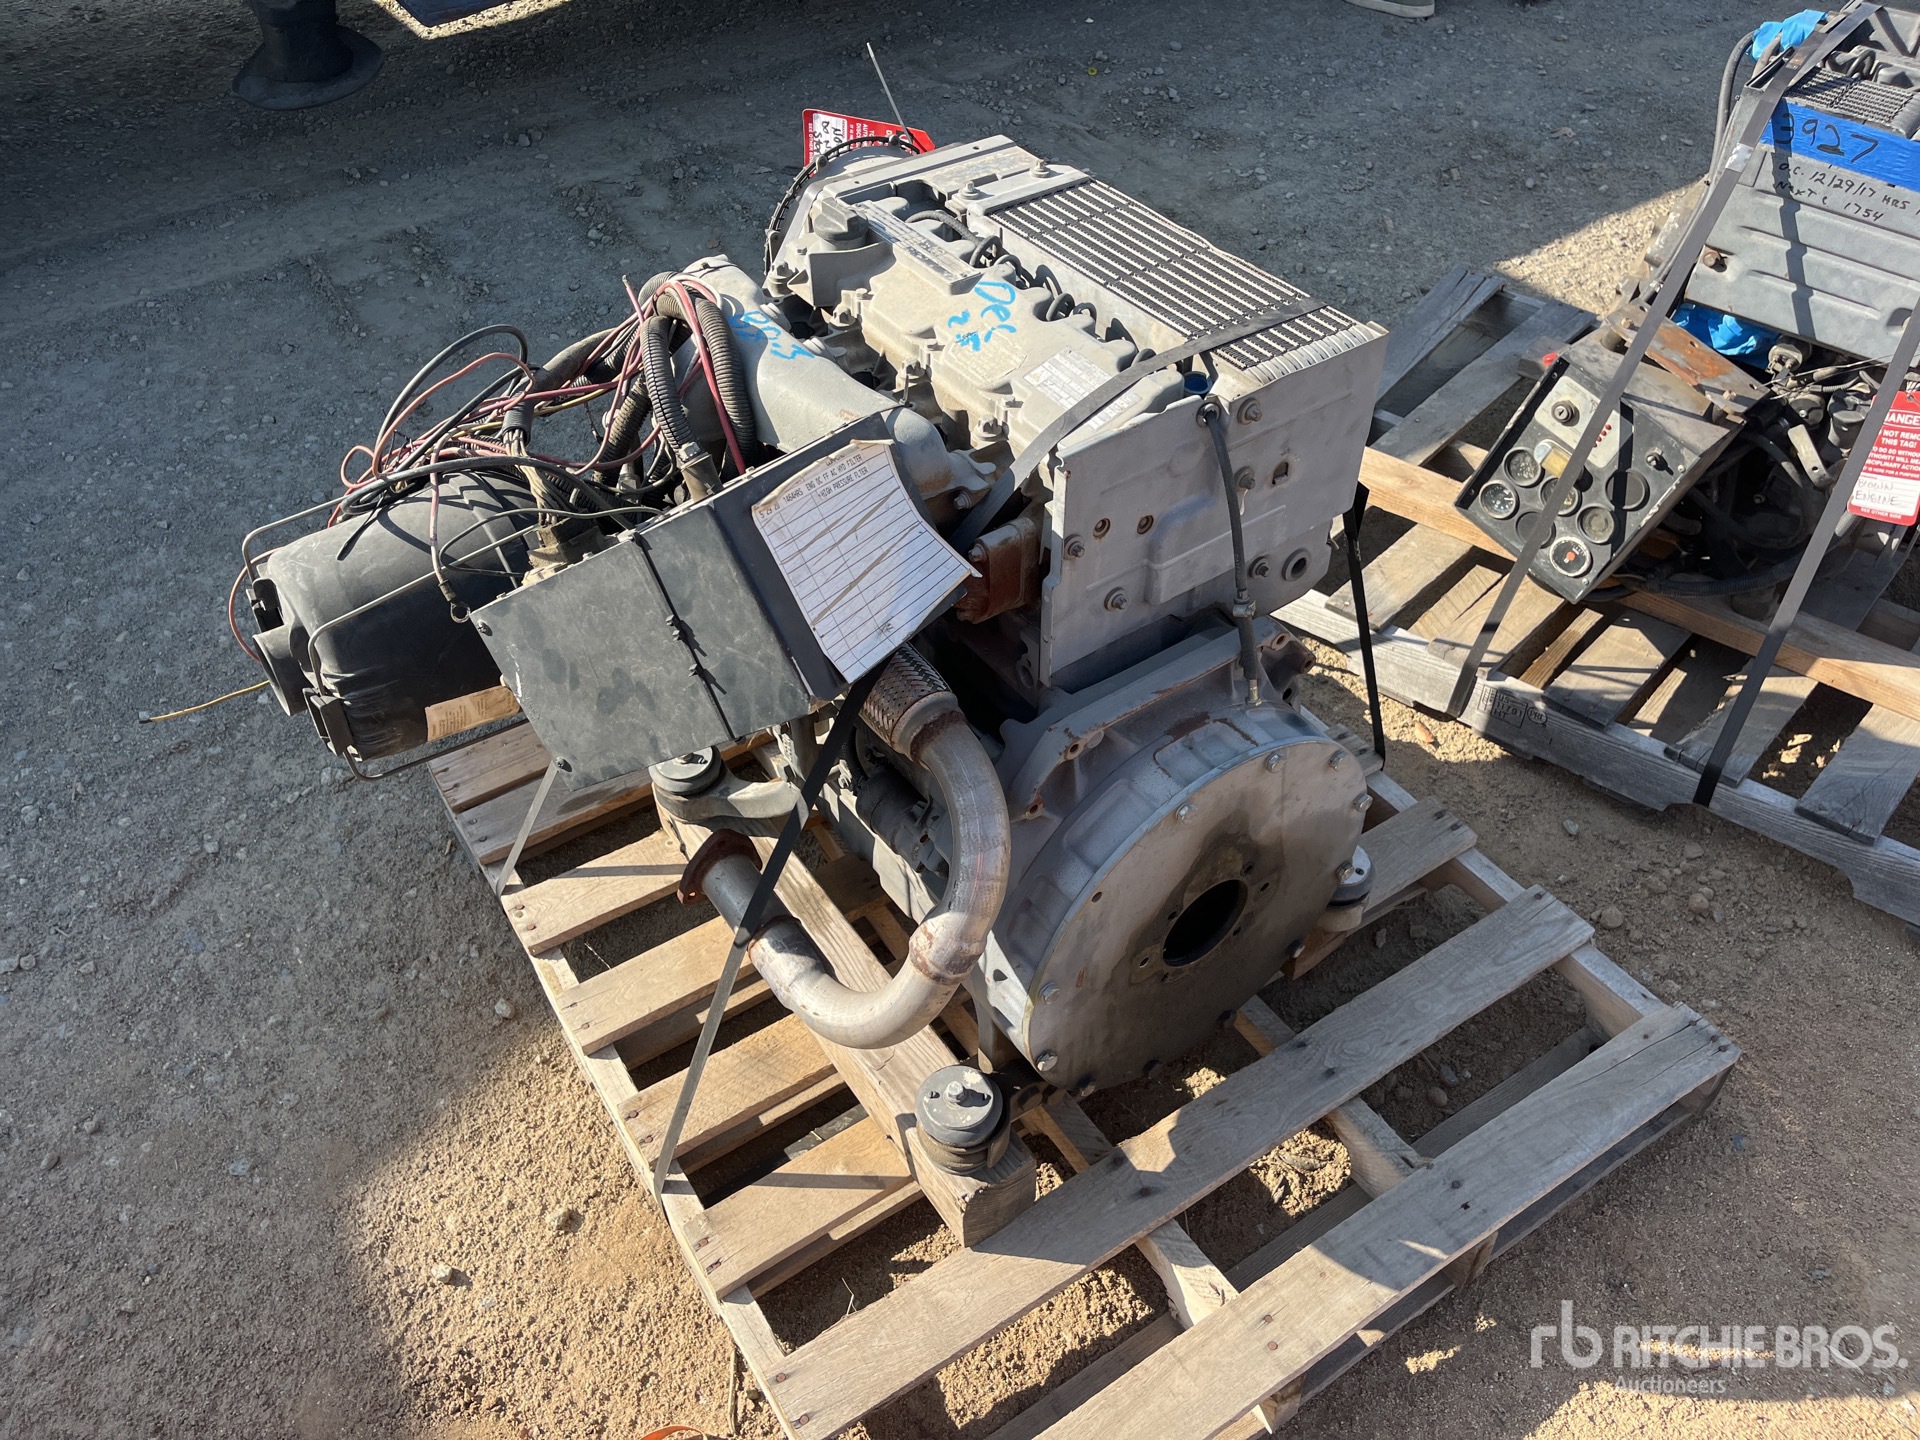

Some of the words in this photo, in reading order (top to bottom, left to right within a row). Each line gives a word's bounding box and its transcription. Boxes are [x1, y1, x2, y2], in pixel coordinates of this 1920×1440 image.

[1774, 112, 1879, 163] 3927
[1809, 171, 1876, 198] 12/29/17
[1881, 194, 1911, 211] HRS
[1844, 202, 1885, 222] 1754
[1881, 437, 1898, 446] THIS
[1900, 440, 1918, 449] TAG!
[1883, 429, 1900, 438] NOT
[1895, 455, 1909, 463] WILL
[805, 480, 816, 491] ENG
[822, 472, 830, 481] FF
[830, 468, 838, 477] AC
[846, 453, 862, 467] FILTER
[820, 486, 833, 498] HIGH
[832, 474, 854, 491] PRESSURE
